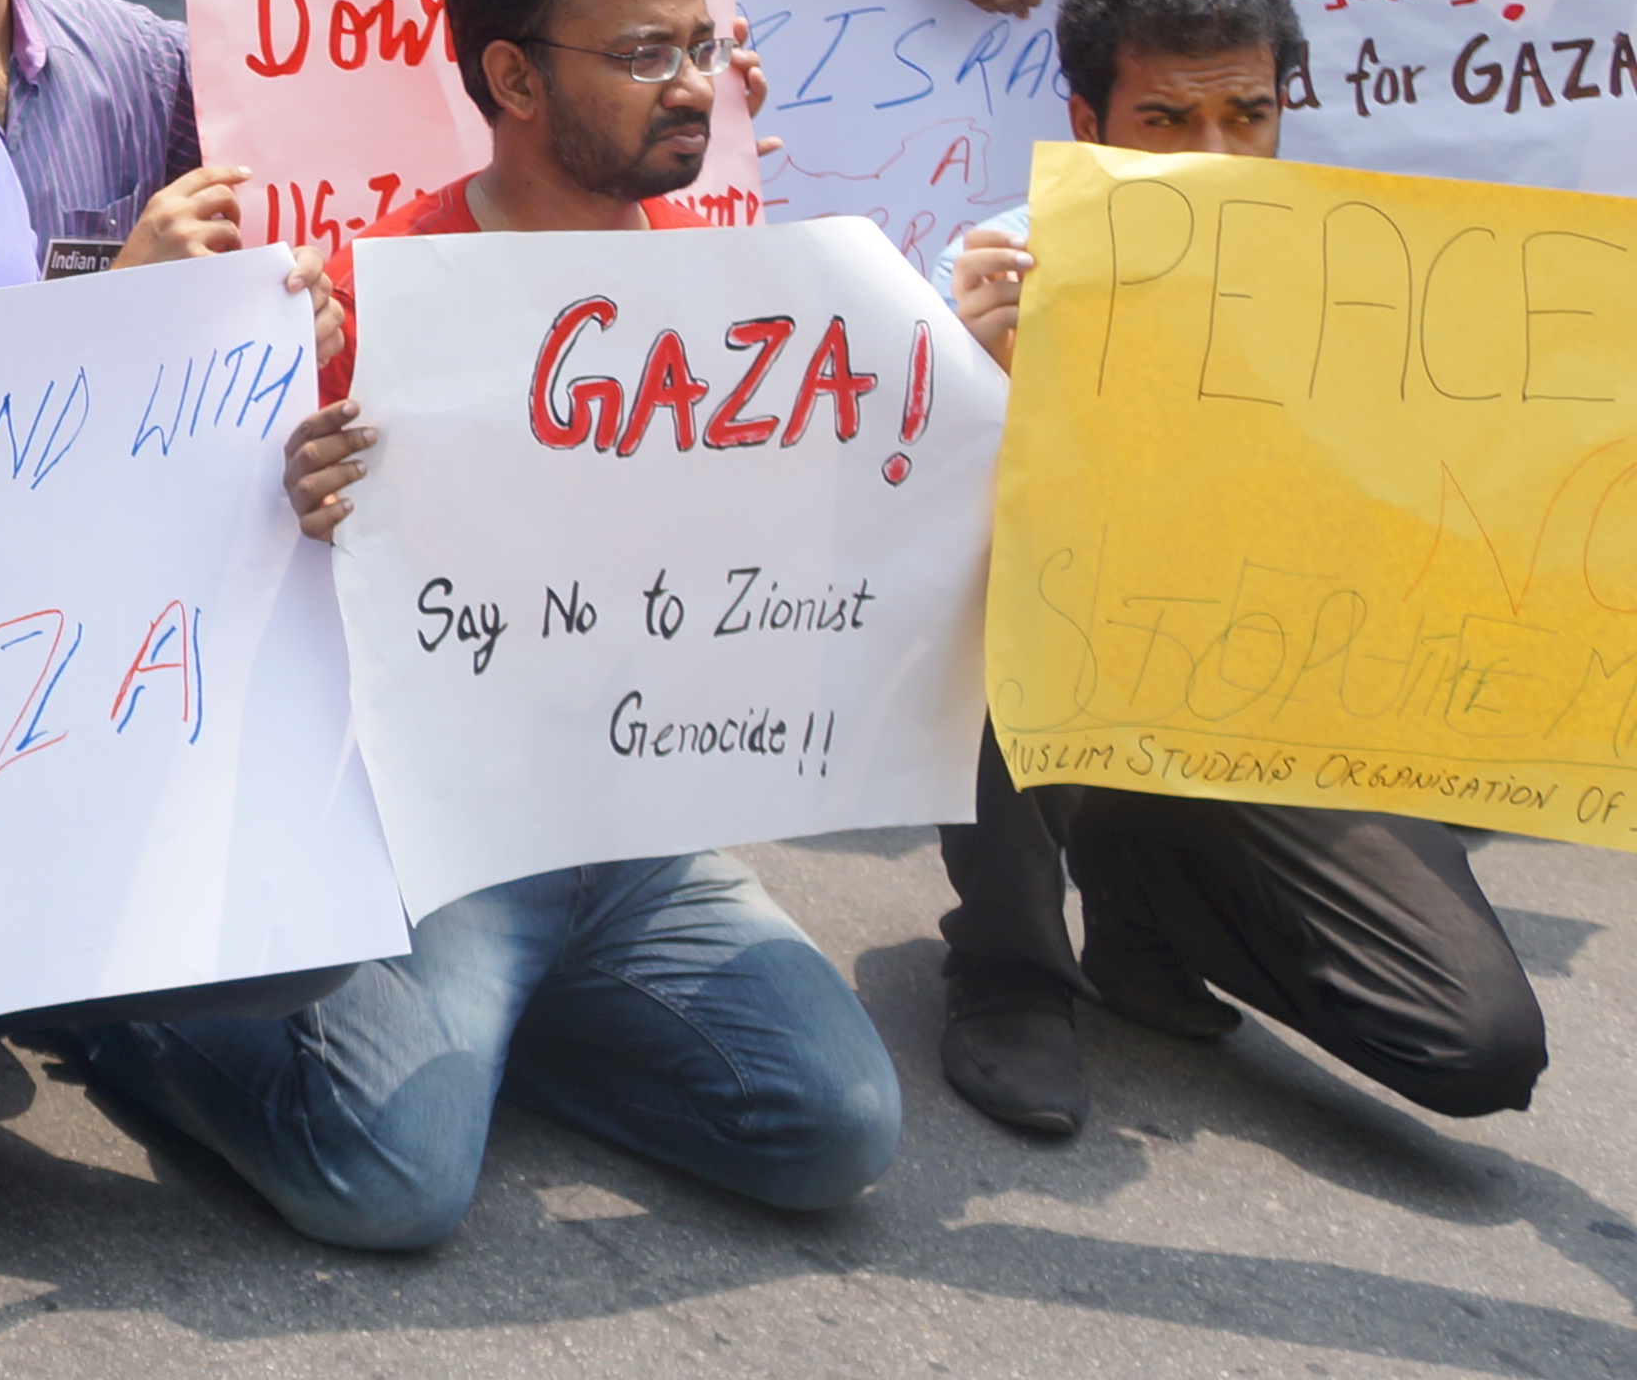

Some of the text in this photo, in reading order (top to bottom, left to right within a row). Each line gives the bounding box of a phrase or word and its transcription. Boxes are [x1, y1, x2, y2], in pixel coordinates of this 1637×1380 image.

[1346, 37, 1427, 117] for
[51, 251, 97, 272] Indian
[1098, 178, 1630, 407] PEACE
[131, 340, 303, 458] WITH
[529, 295, 934, 487] GAZA!
[417, 567, 876, 675] Say No to Zionist
[1315, 754, 1559, 811] ORGANISATION
